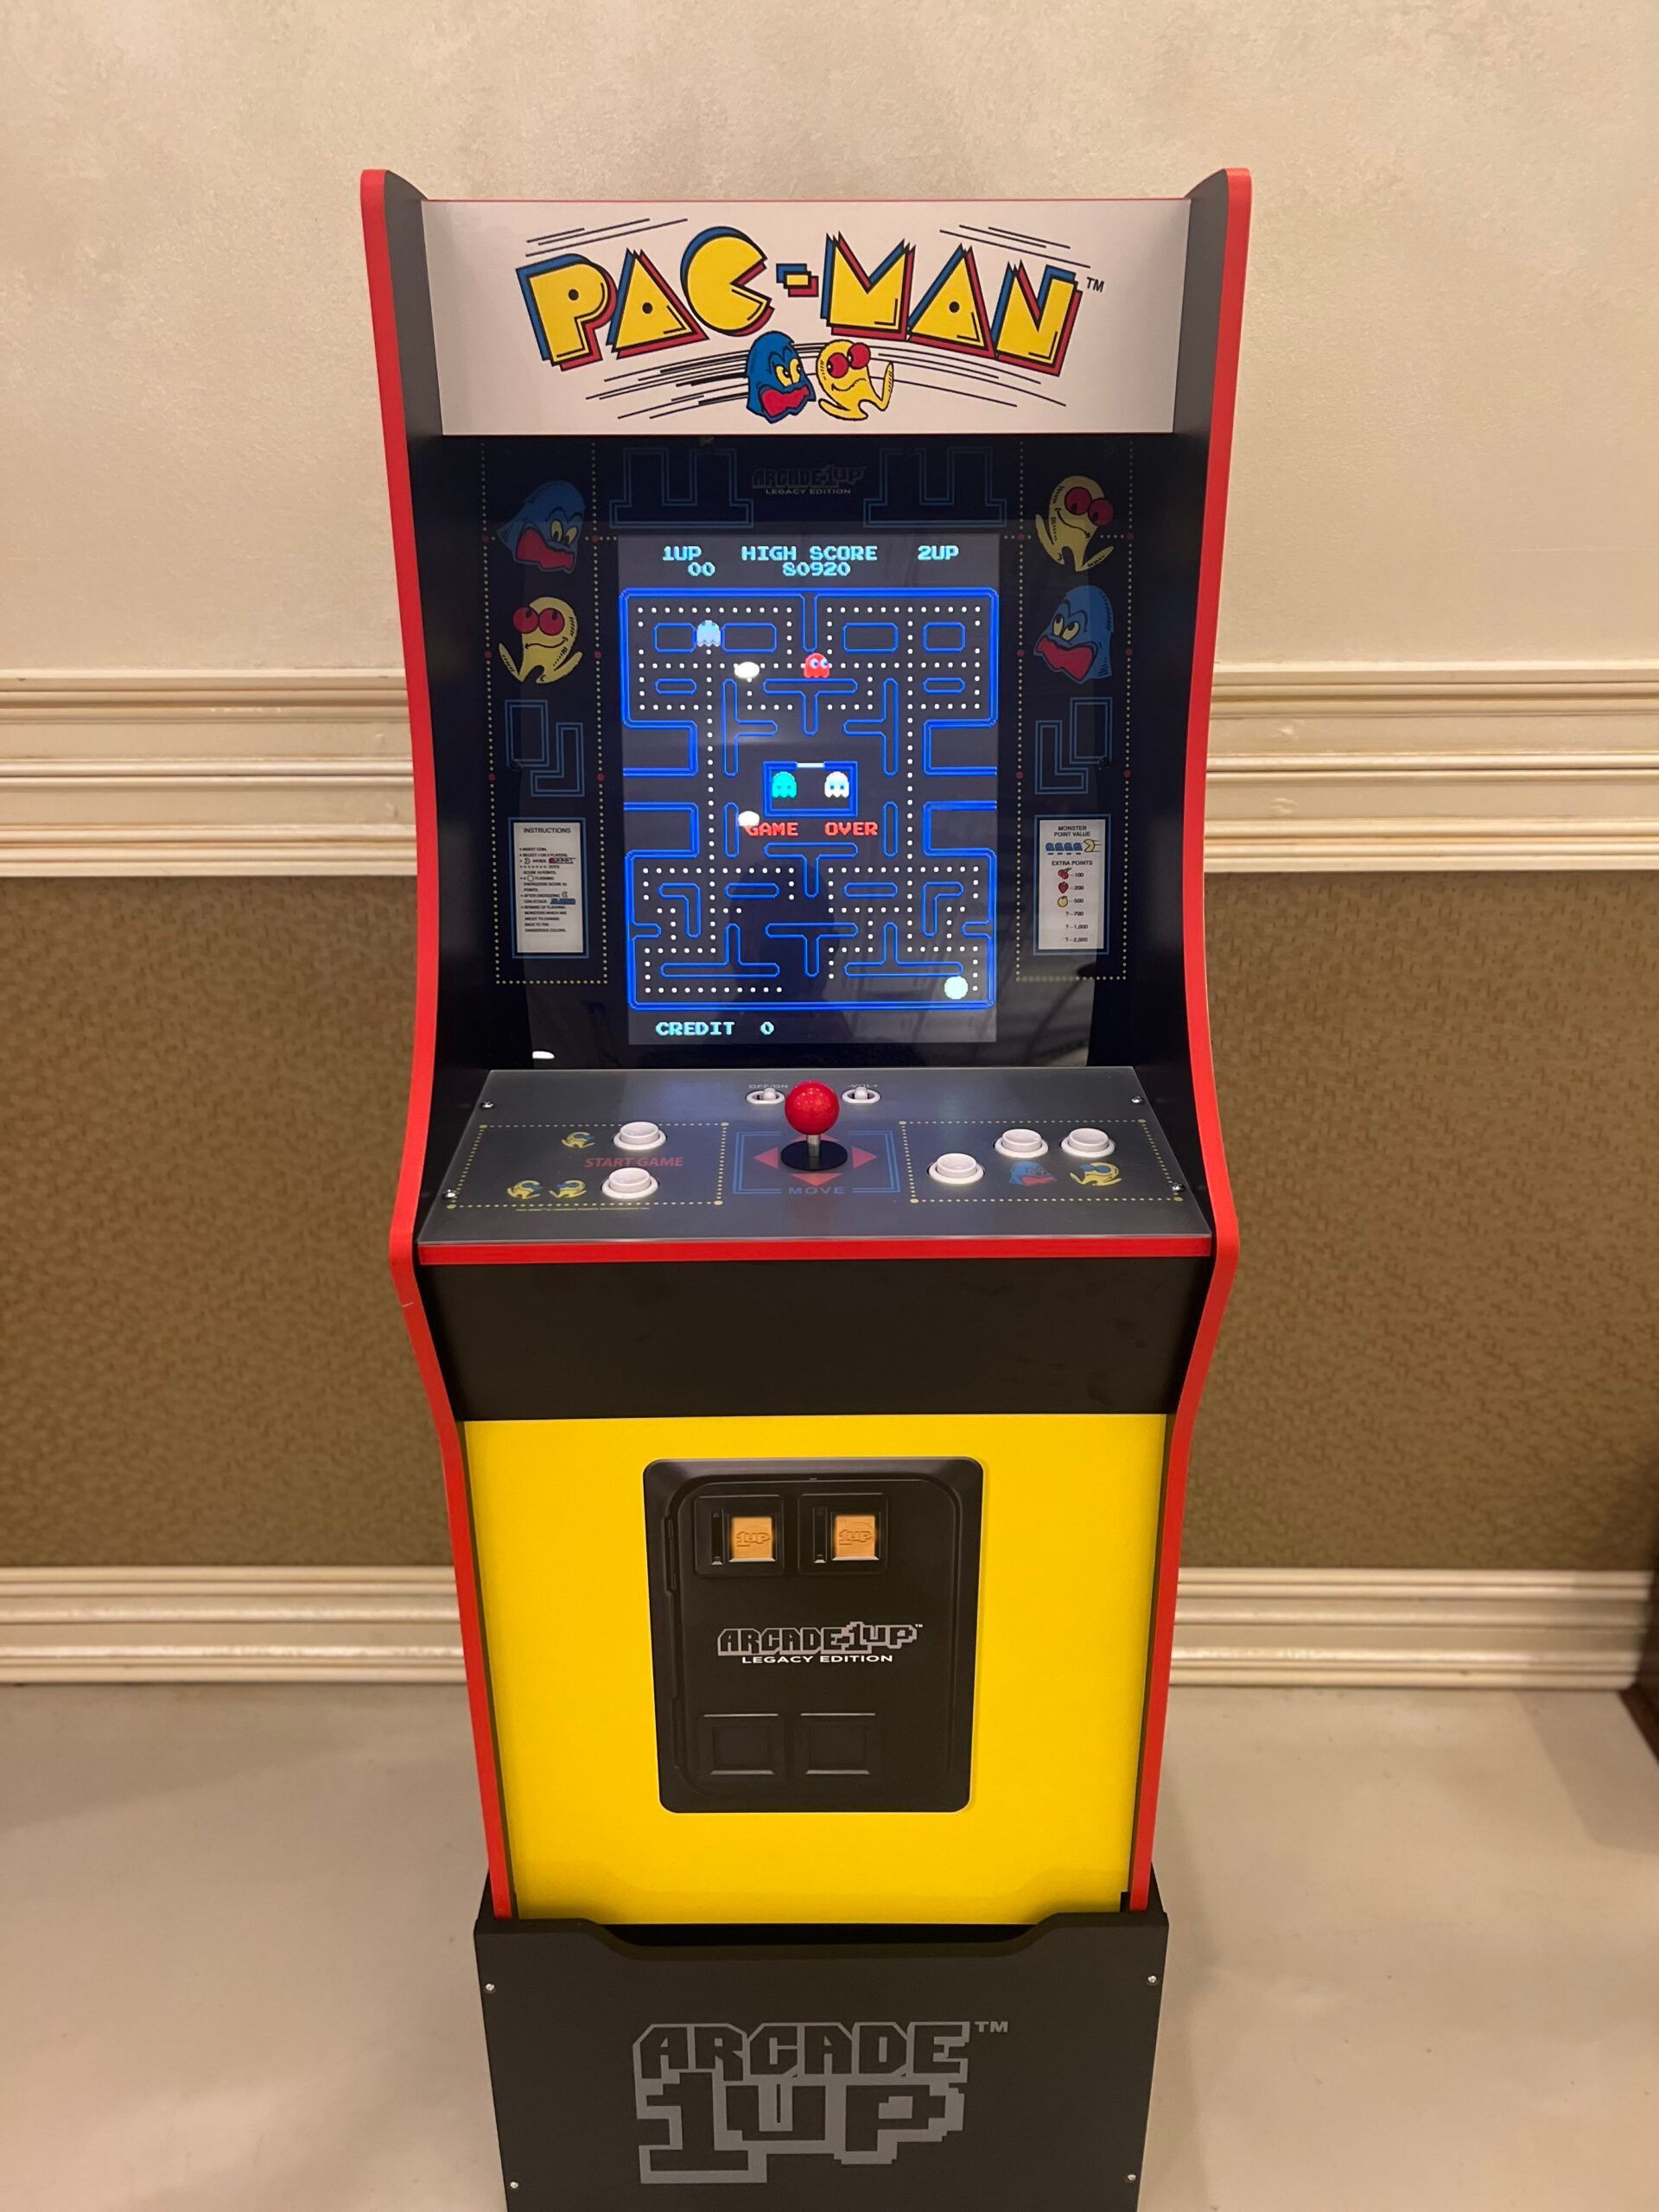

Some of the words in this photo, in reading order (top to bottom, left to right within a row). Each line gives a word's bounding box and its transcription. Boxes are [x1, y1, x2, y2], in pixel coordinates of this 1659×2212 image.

[516, 226, 1084, 376] PAC-MAN
[662, 545, 702, 562] 1UP
[741, 545, 797, 562] HIGH
[810, 545, 878, 562] SCORE
[917, 544, 960, 561] 2UP
[687, 562, 716, 577] 00
[782, 562, 851, 577] 80920
[744, 822, 799, 836] GAME
[824, 822, 879, 836] OVER
[655, 1021, 735, 1036] CREDIT
[760, 1021, 775, 1035] 0
[584, 1156, 632, 1167] START
[637, 1156, 684, 1167] GAME
[741, 1656, 815, 1664] LEGACY
[819, 1654, 893, 1663] EDITION
[632, 2021, 970, 2083] ARCADE
[635, 2070, 966, 2184] 1UP
